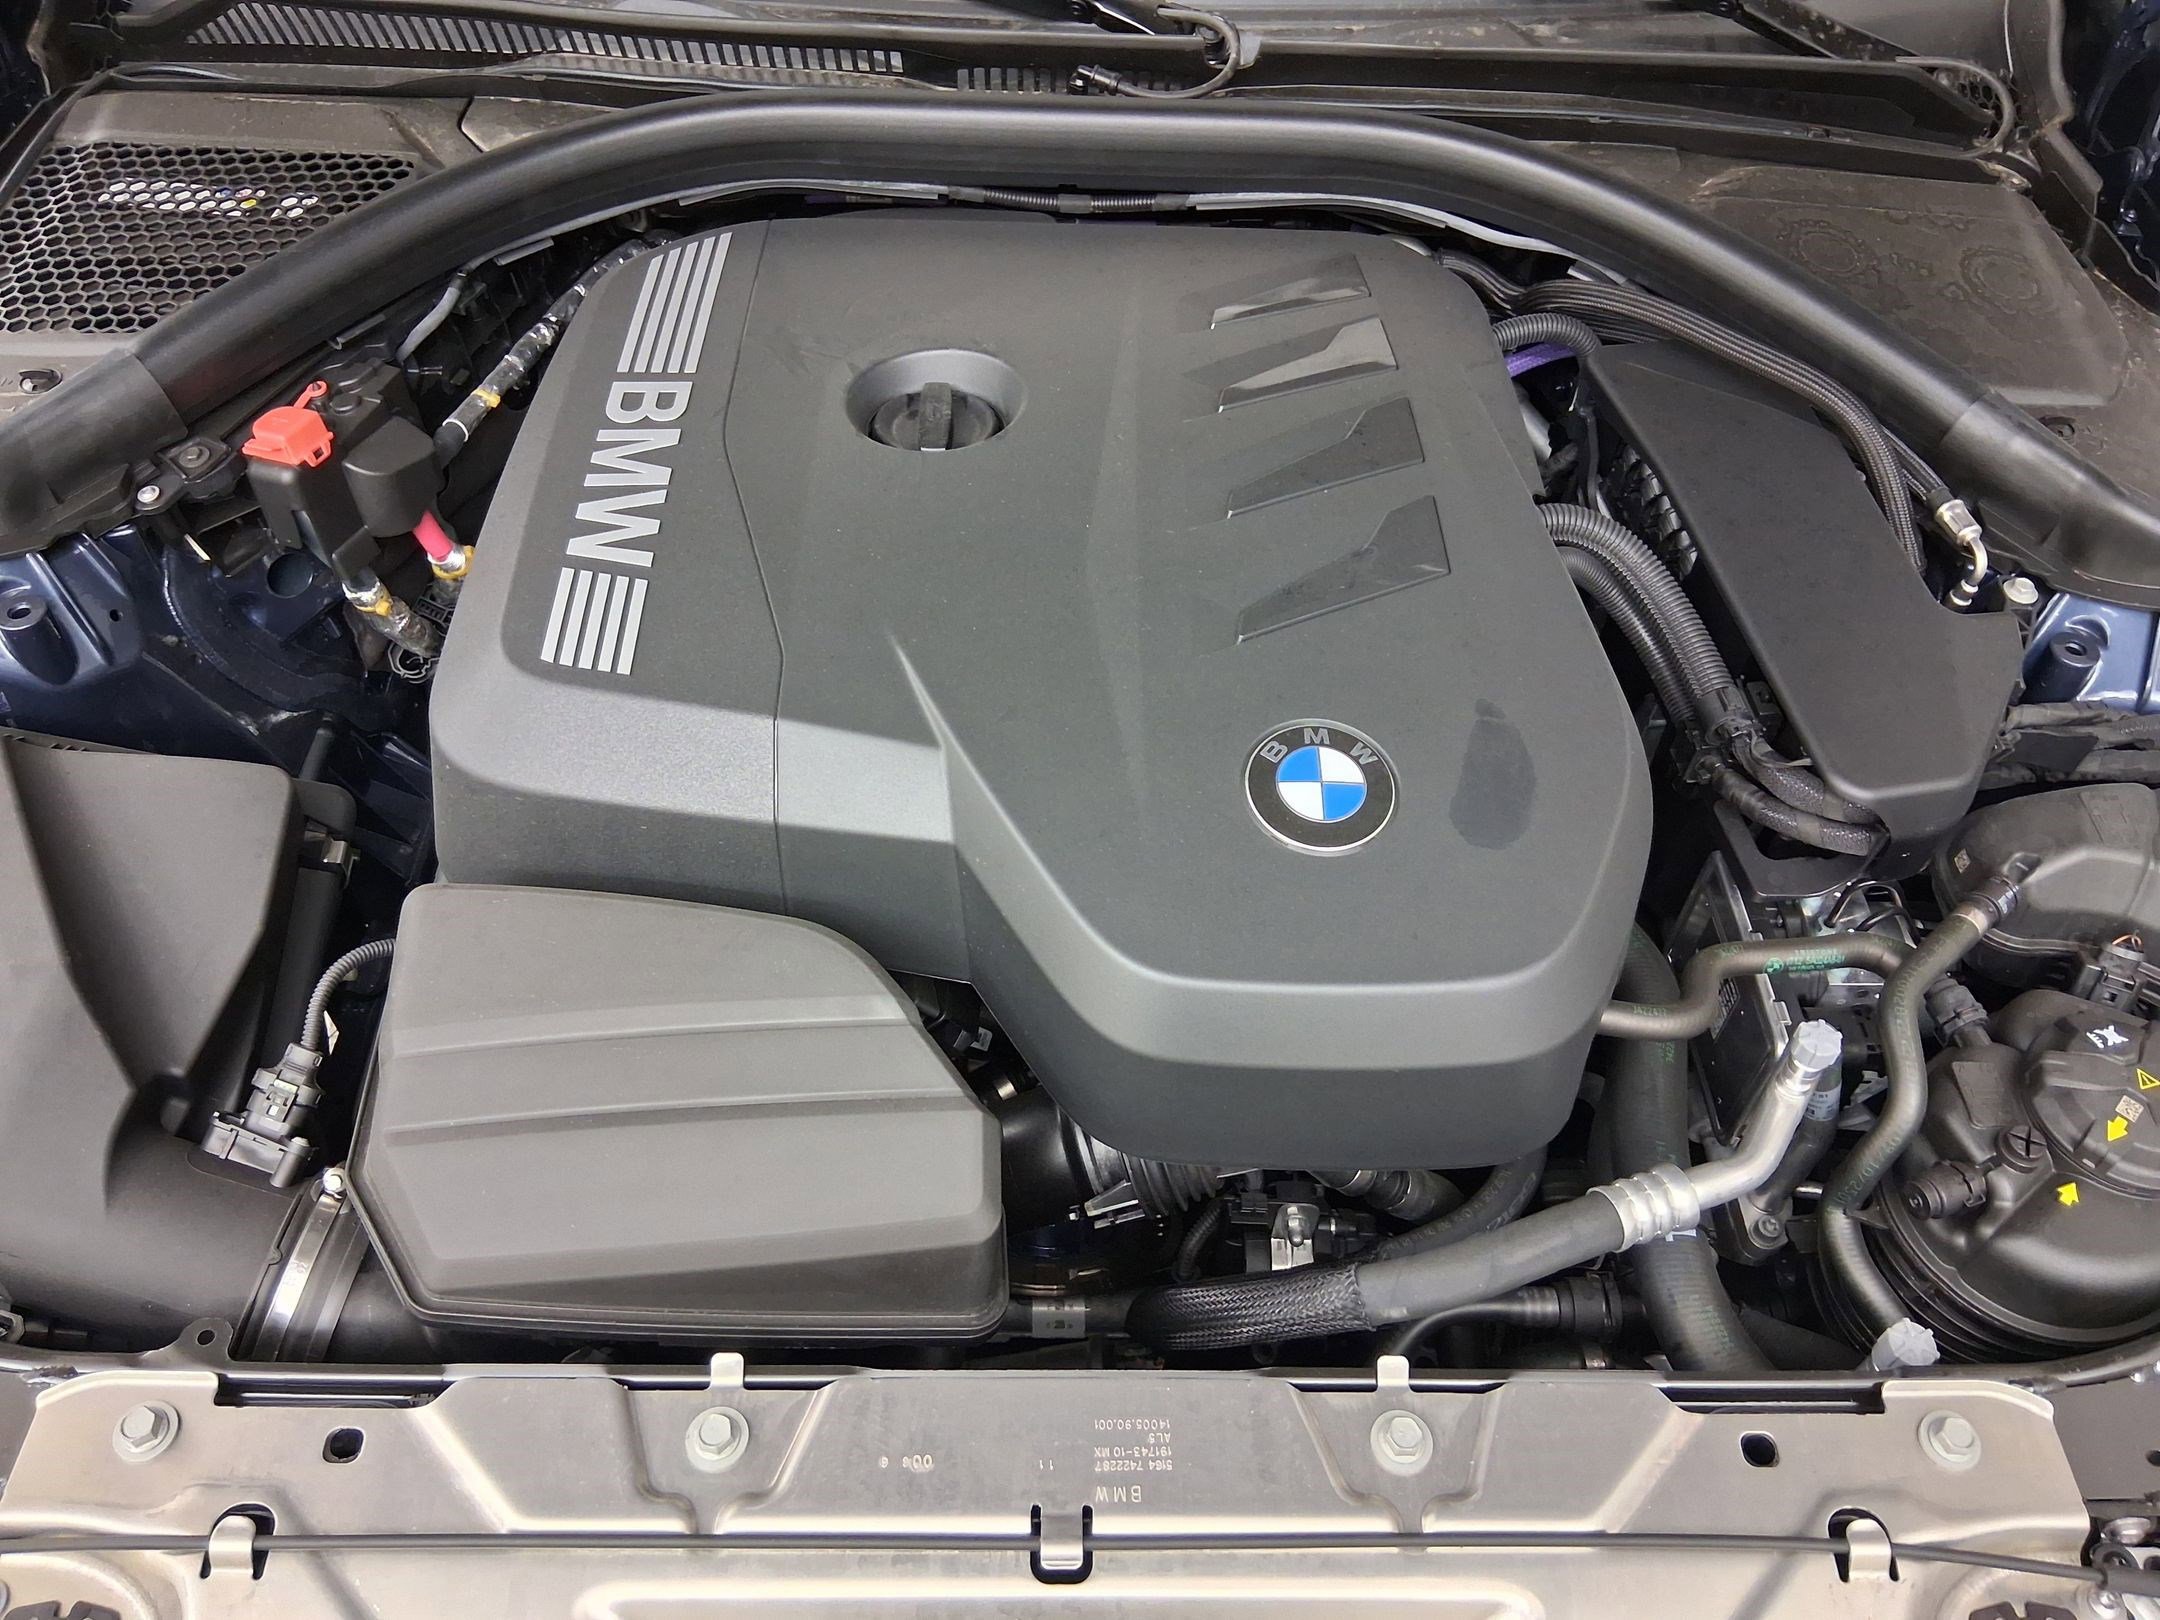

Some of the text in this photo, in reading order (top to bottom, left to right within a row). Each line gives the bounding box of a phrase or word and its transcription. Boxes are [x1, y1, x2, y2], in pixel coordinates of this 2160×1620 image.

[566, 381, 693, 568] BMW
[1259, 727, 1379, 766] BMW
[1113, 1446, 1172, 1457] 191743-10
[1094, 1459, 1173, 1472] 5164 7422287
[1095, 1485, 1142, 1502] BMW
